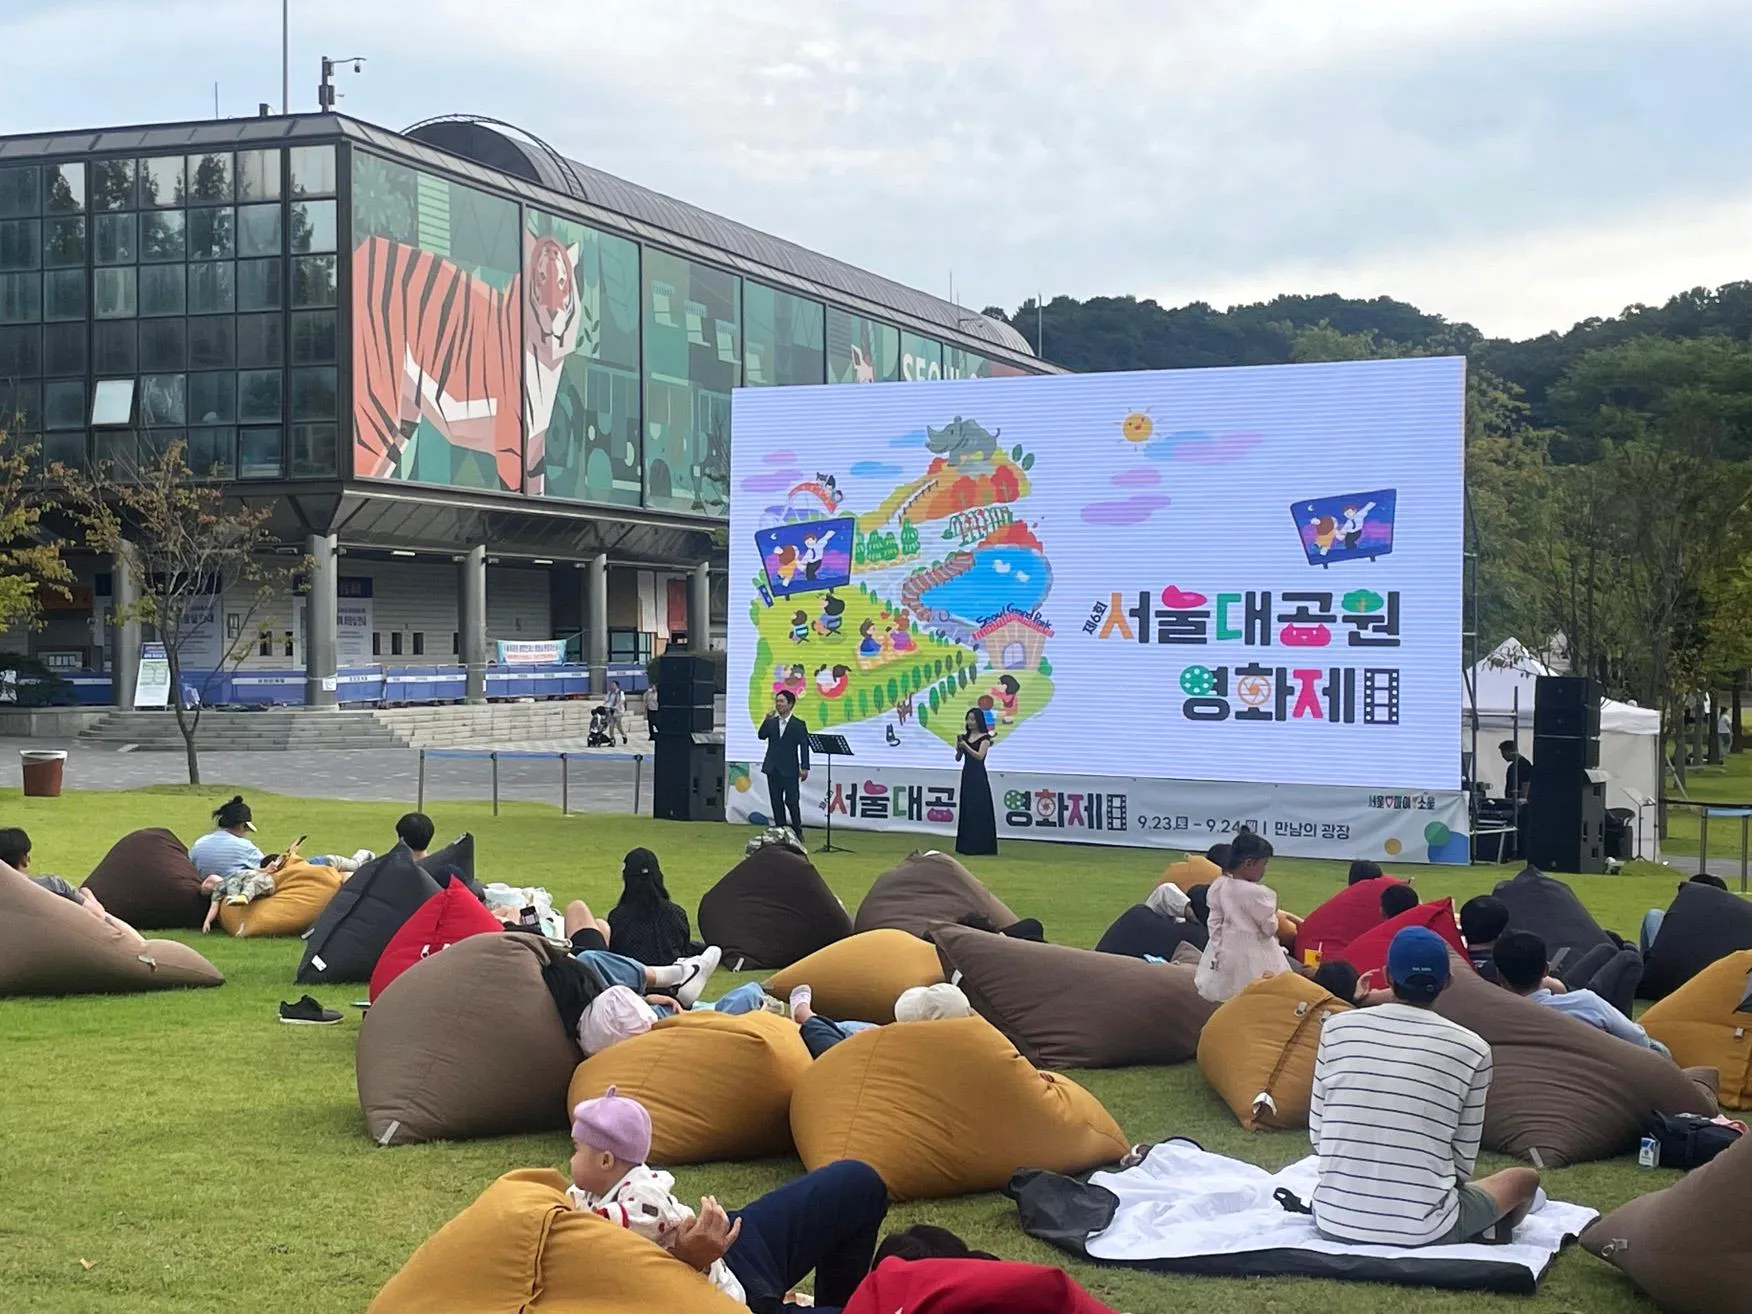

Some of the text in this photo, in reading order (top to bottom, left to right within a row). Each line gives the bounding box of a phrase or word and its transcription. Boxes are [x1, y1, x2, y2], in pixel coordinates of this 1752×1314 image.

[976, 606, 1005, 629] Seoul
[1099, 585, 1401, 647] 서울대공원
[1179, 662, 1356, 724] 영화제
[828, 780, 957, 822] 서울대공
[1003, 788, 1103, 830] 영화제
[1274, 822, 1317, 837] 만남의
[1321, 824, 1351, 840] 광장
